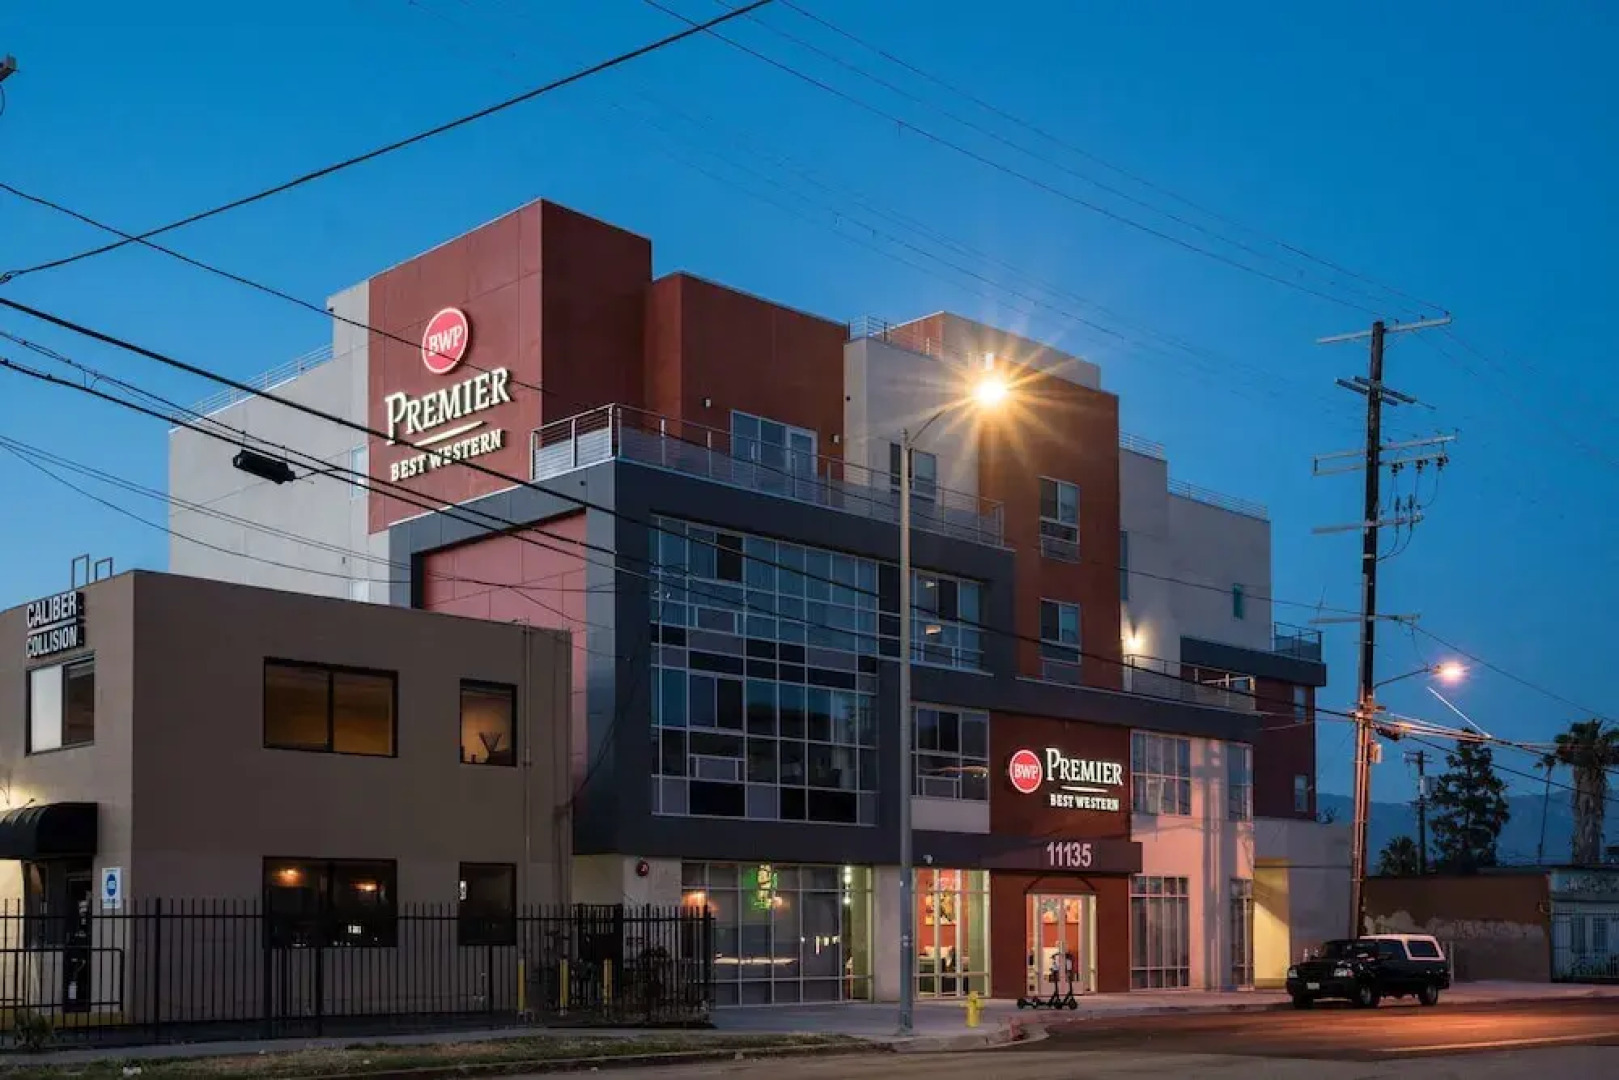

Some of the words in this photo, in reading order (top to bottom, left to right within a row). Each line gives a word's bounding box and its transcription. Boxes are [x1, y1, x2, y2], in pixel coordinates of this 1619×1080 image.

[428, 325, 463, 357] BWP
[384, 367, 510, 446] PREMIER
[390, 454, 427, 482] BEST
[428, 428, 502, 469] WESTERN
[27, 590, 77, 628] CALIBER
[26, 624, 78, 658] COLLISION
[1014, 763, 1039, 780] BWP
[1046, 747, 1123, 785] PREMIER
[1050, 793, 1074, 809] BEST
[1074, 796, 1120, 812] WESTERN
[1047, 841, 1092, 867] 11135
